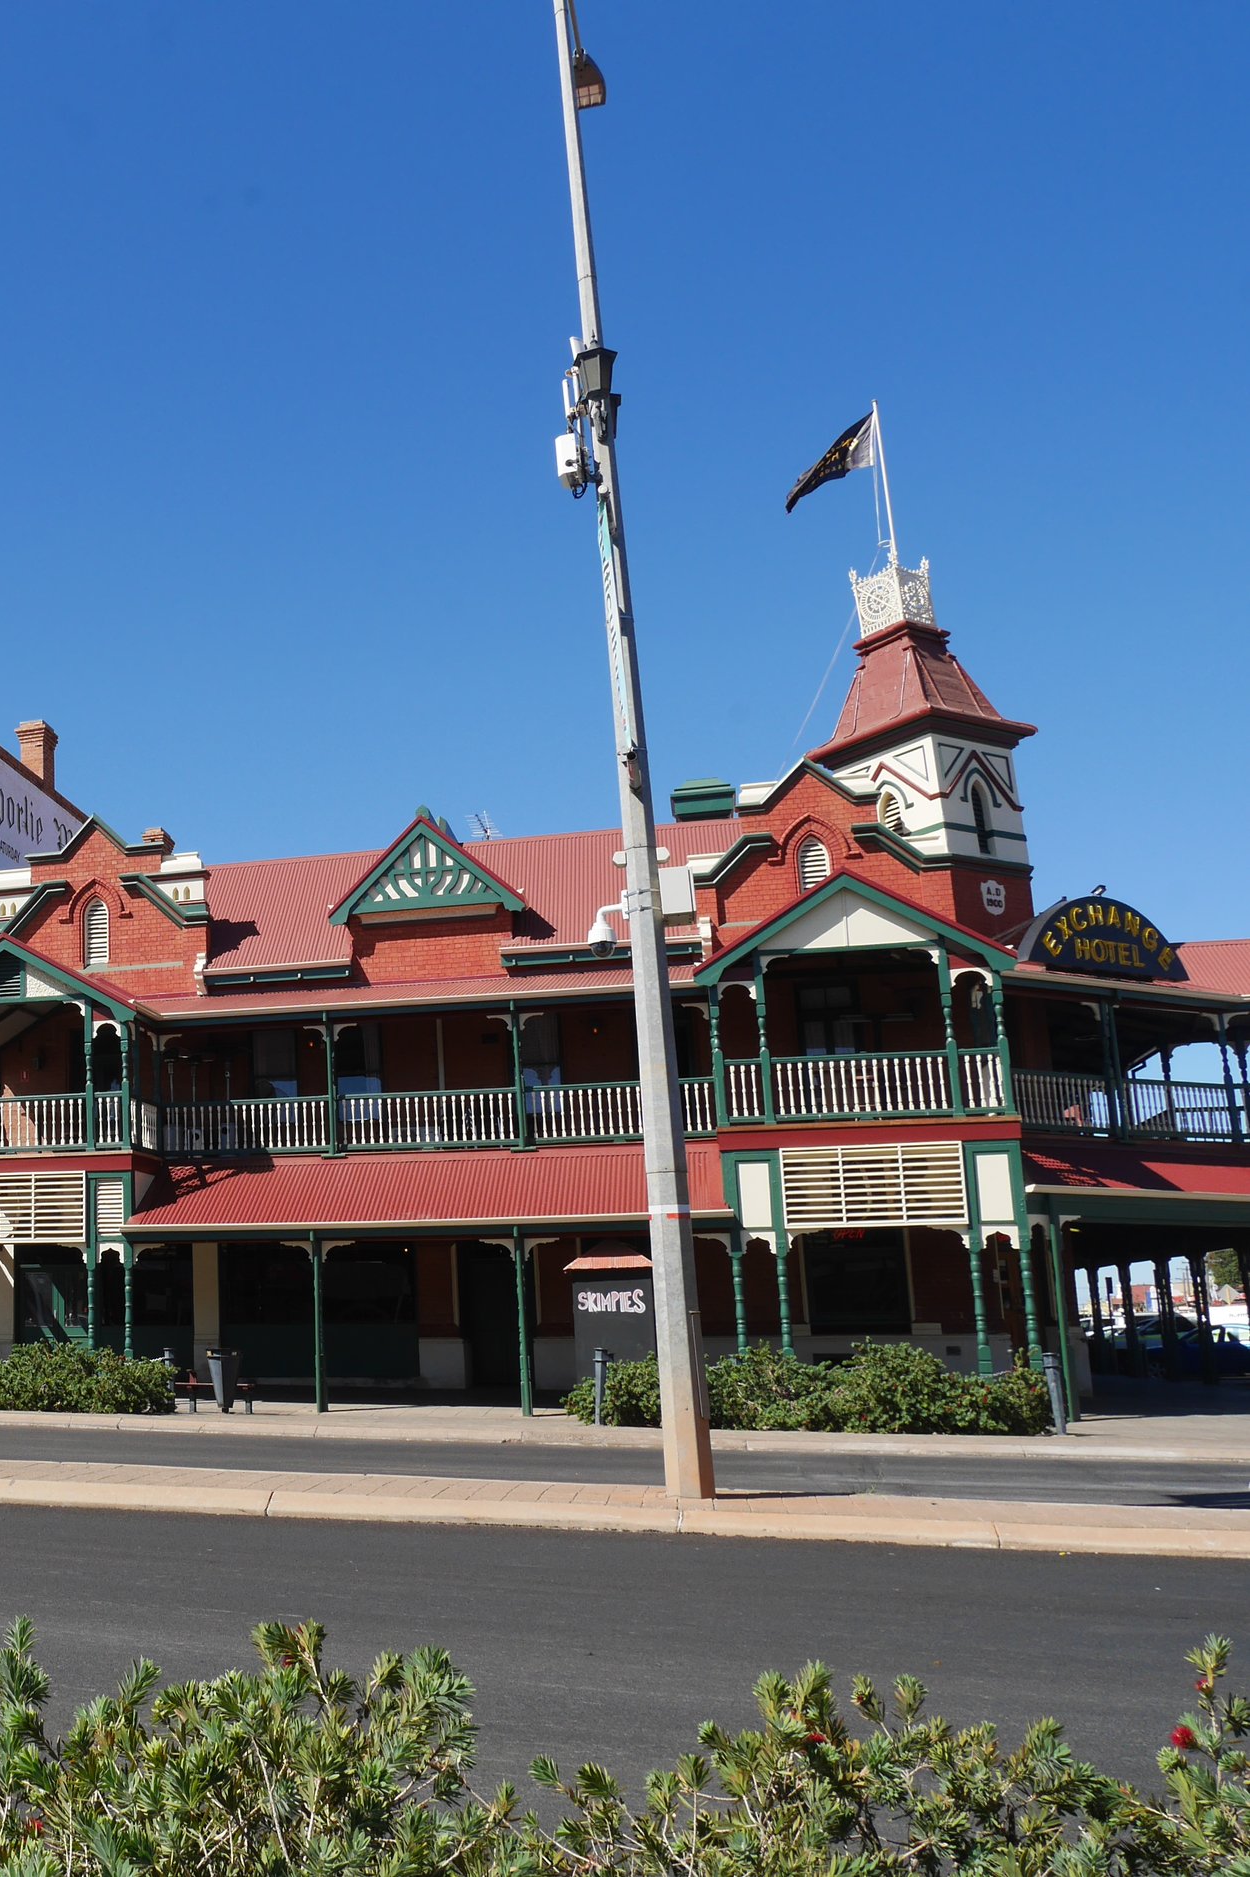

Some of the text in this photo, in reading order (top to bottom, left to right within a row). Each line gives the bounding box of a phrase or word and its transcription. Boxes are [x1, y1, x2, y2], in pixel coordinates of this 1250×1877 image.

[1042, 904, 1176, 972] EXCHANGE
[1074, 937, 1146, 968] HOTEL
[833, 1229, 866, 1240] OPEN
[577, 1289, 646, 1313] SKIMPIES
